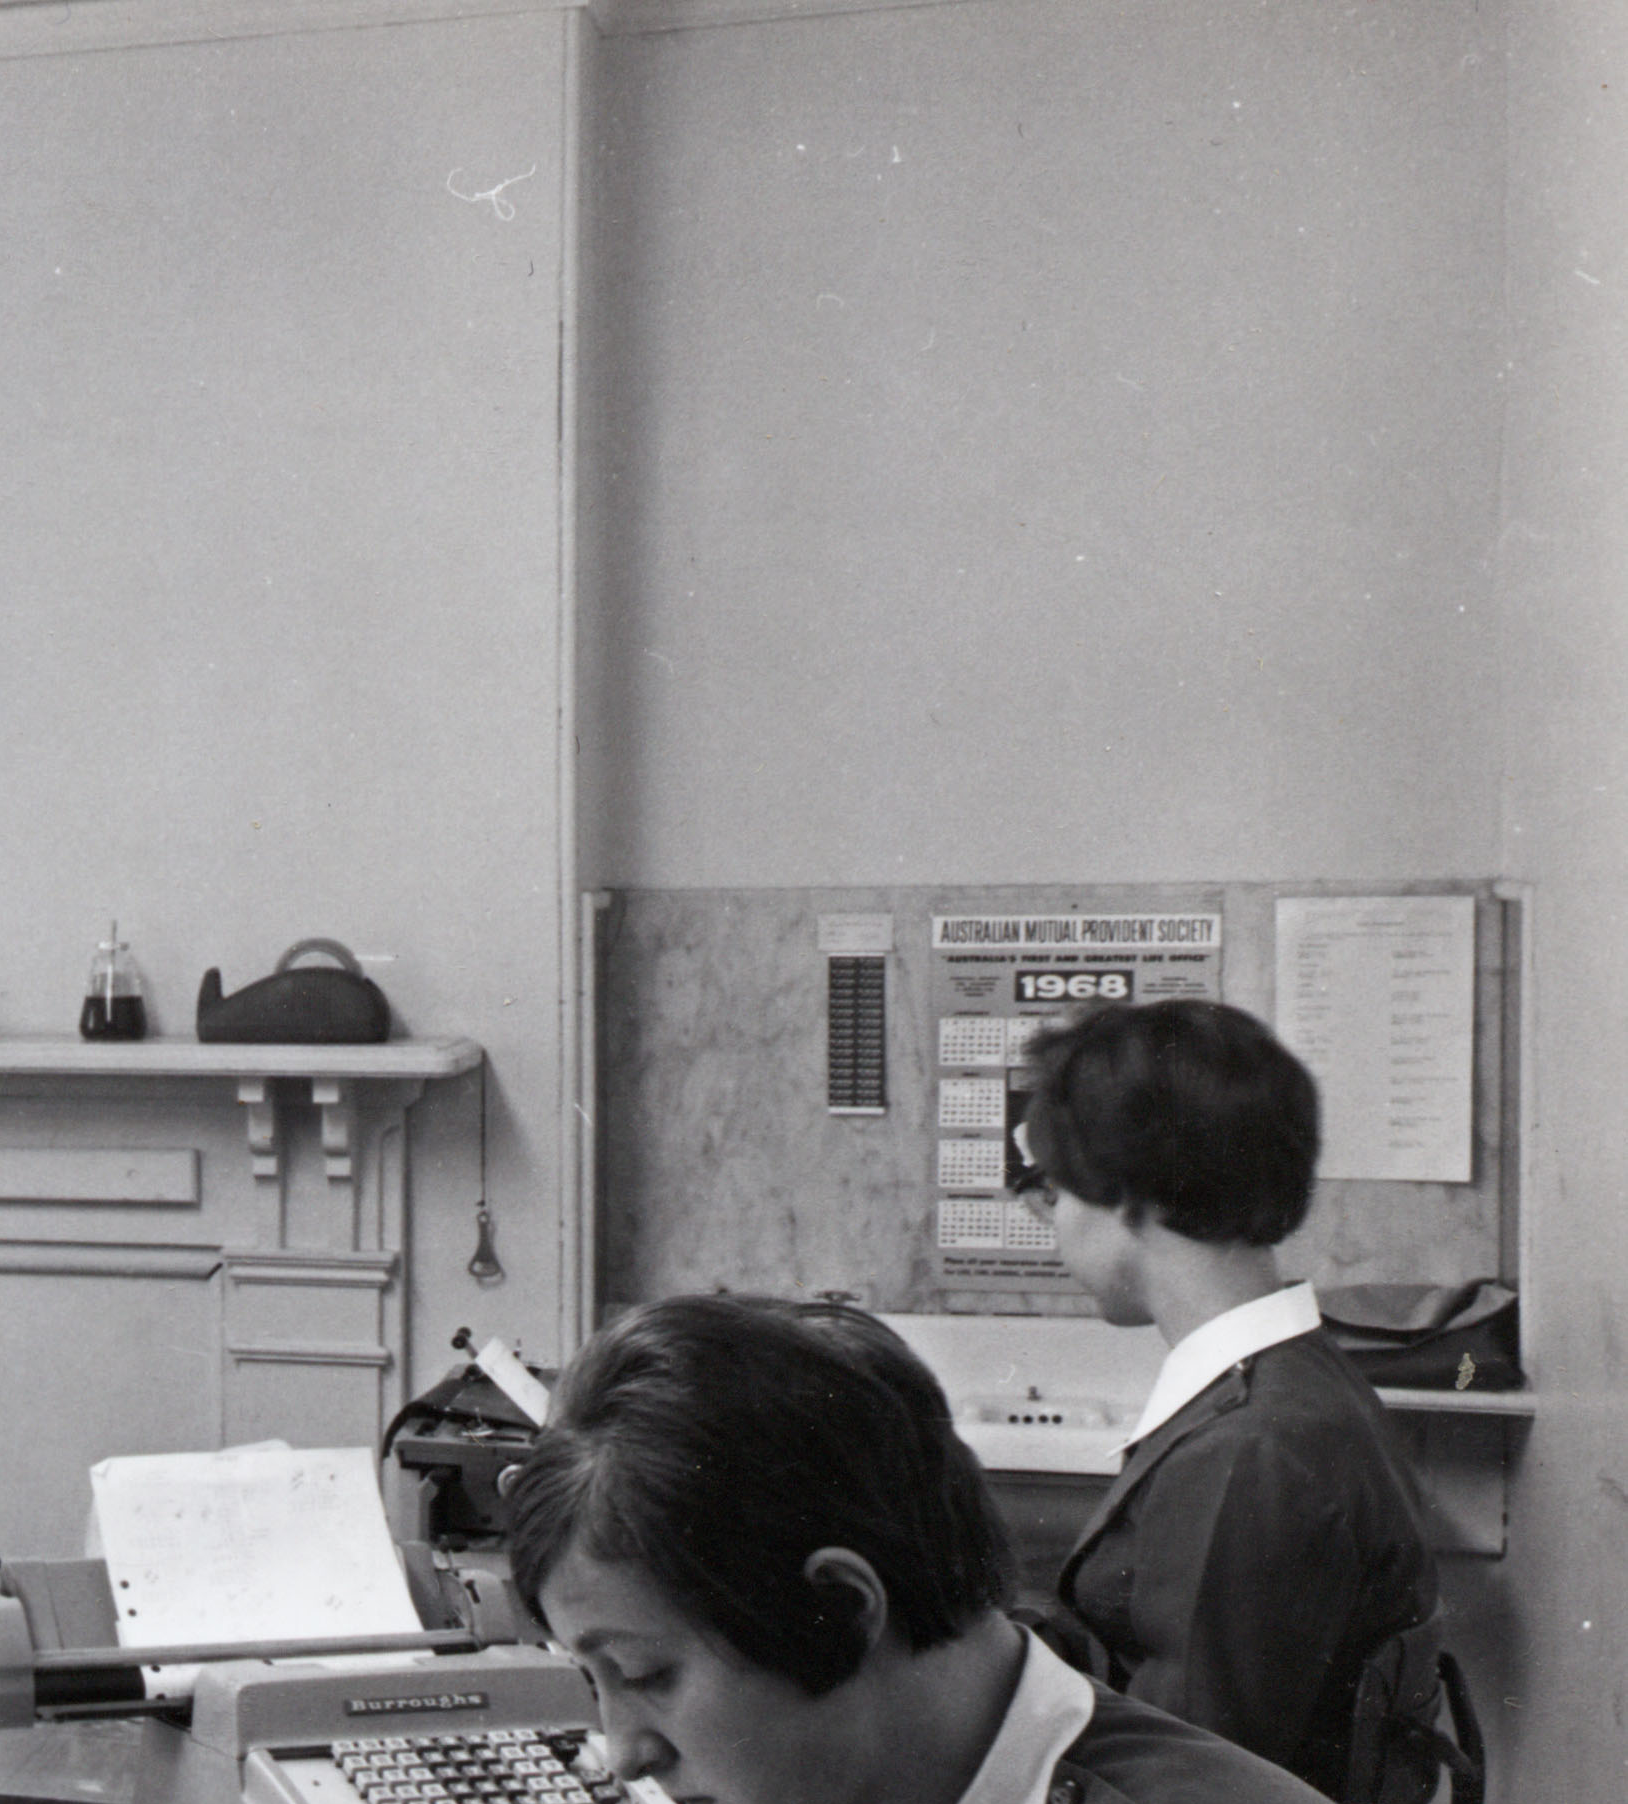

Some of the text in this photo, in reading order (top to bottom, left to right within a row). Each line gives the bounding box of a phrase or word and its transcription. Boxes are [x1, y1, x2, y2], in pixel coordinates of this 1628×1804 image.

[940, 919, 1214, 943] AUSTRALIAN MUTUAL PROVIDENT SOCIETY
[1054, 955, 1079, 963] AND
[1142, 954, 1164, 963] LIFE
[1019, 974, 1129, 999] 1968
[350, 1693, 482, 1712] Burroughs
